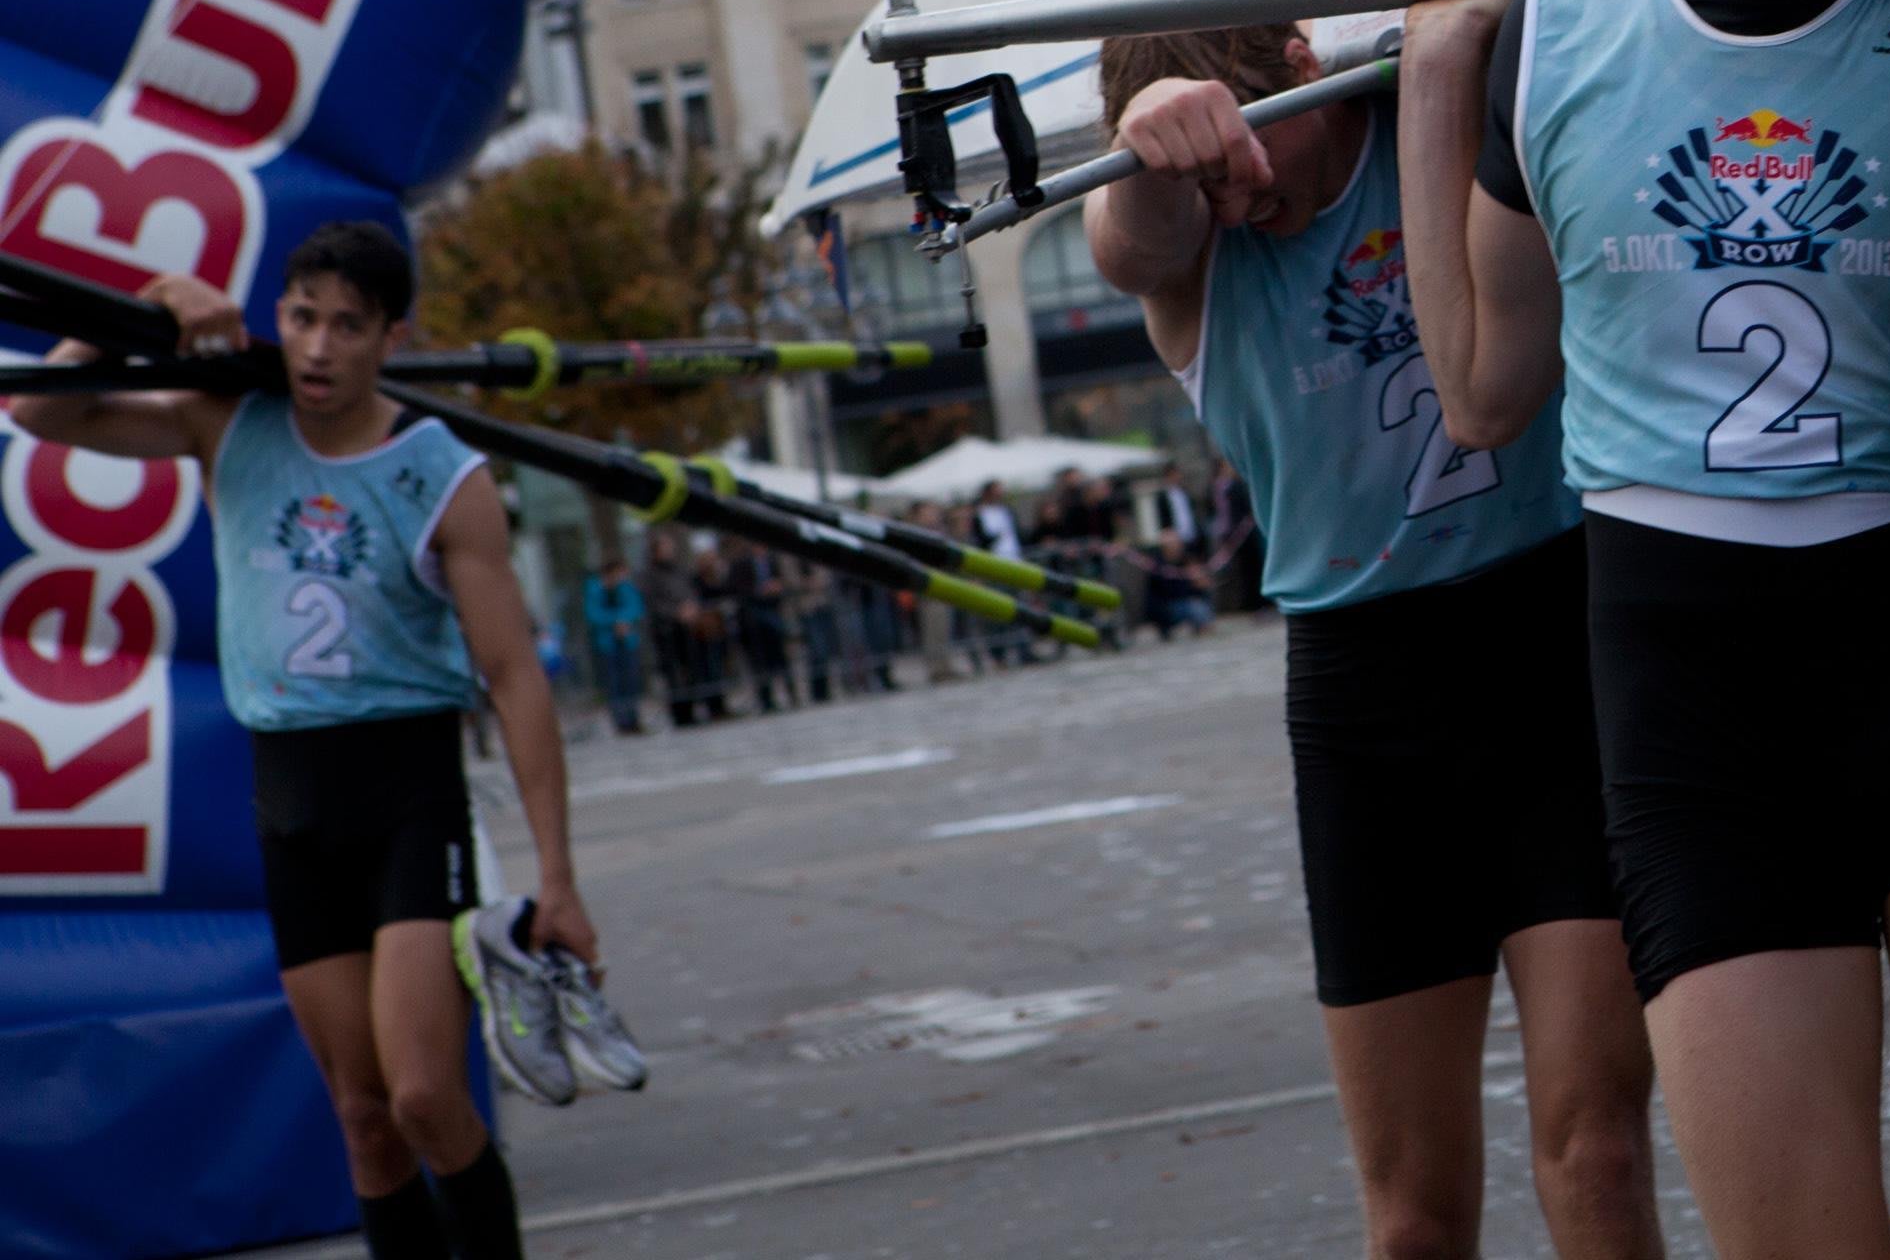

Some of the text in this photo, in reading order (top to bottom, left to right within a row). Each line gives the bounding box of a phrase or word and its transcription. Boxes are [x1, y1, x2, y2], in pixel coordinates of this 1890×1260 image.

[1710, 154, 1815, 181] Red Bull
[1715, 179, 1805, 238] X
[1602, 232, 1684, 273] 5.OKT.
[1720, 240, 1801, 264] ROW
[1697, 279, 1844, 473] 2
[1378, 351, 1504, 520] 2
[286, 577, 351, 678] 2
